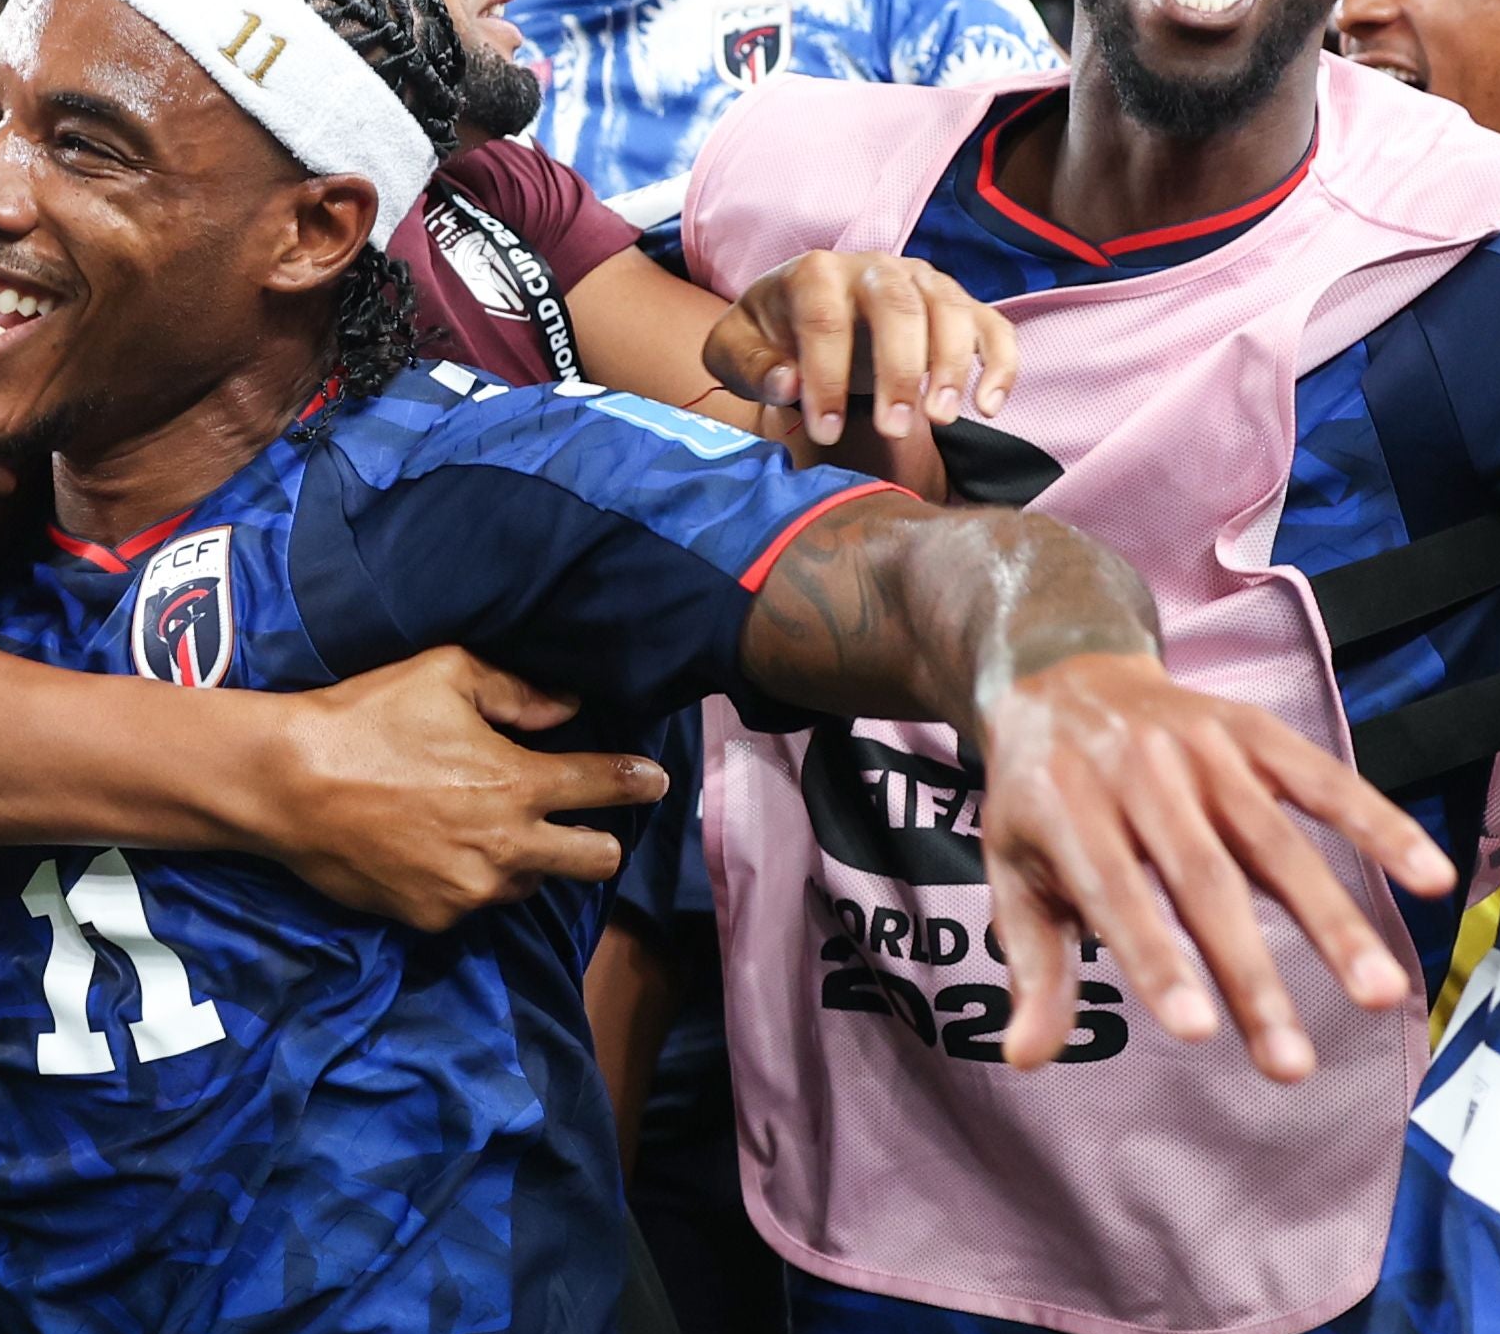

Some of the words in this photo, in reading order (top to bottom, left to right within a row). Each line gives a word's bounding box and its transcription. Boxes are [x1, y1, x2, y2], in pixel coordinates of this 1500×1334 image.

[217, 9, 287, 89] 11
[508, 247, 550, 298] CUP
[537, 296, 582, 383] WORLD
[150, 538, 220, 580] FCF
[20, 846, 227, 1075] 11
